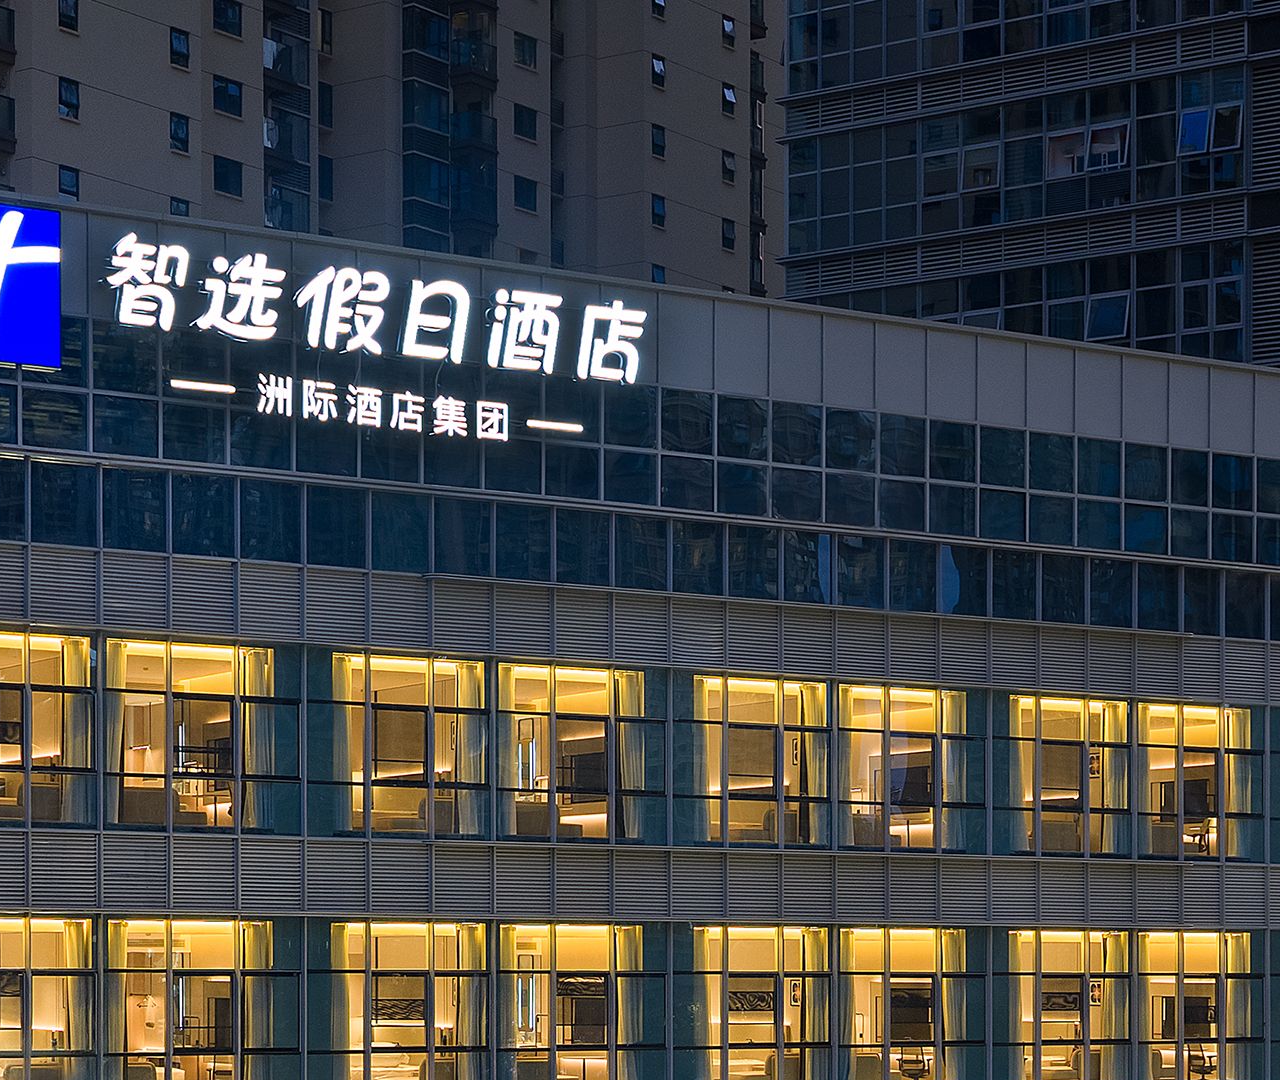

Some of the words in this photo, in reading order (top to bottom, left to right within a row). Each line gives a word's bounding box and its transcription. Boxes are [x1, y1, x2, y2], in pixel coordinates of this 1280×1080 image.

[106, 232, 648, 385] 智选假日酒店
[256, 373, 509, 442] 洲际酒店集团
